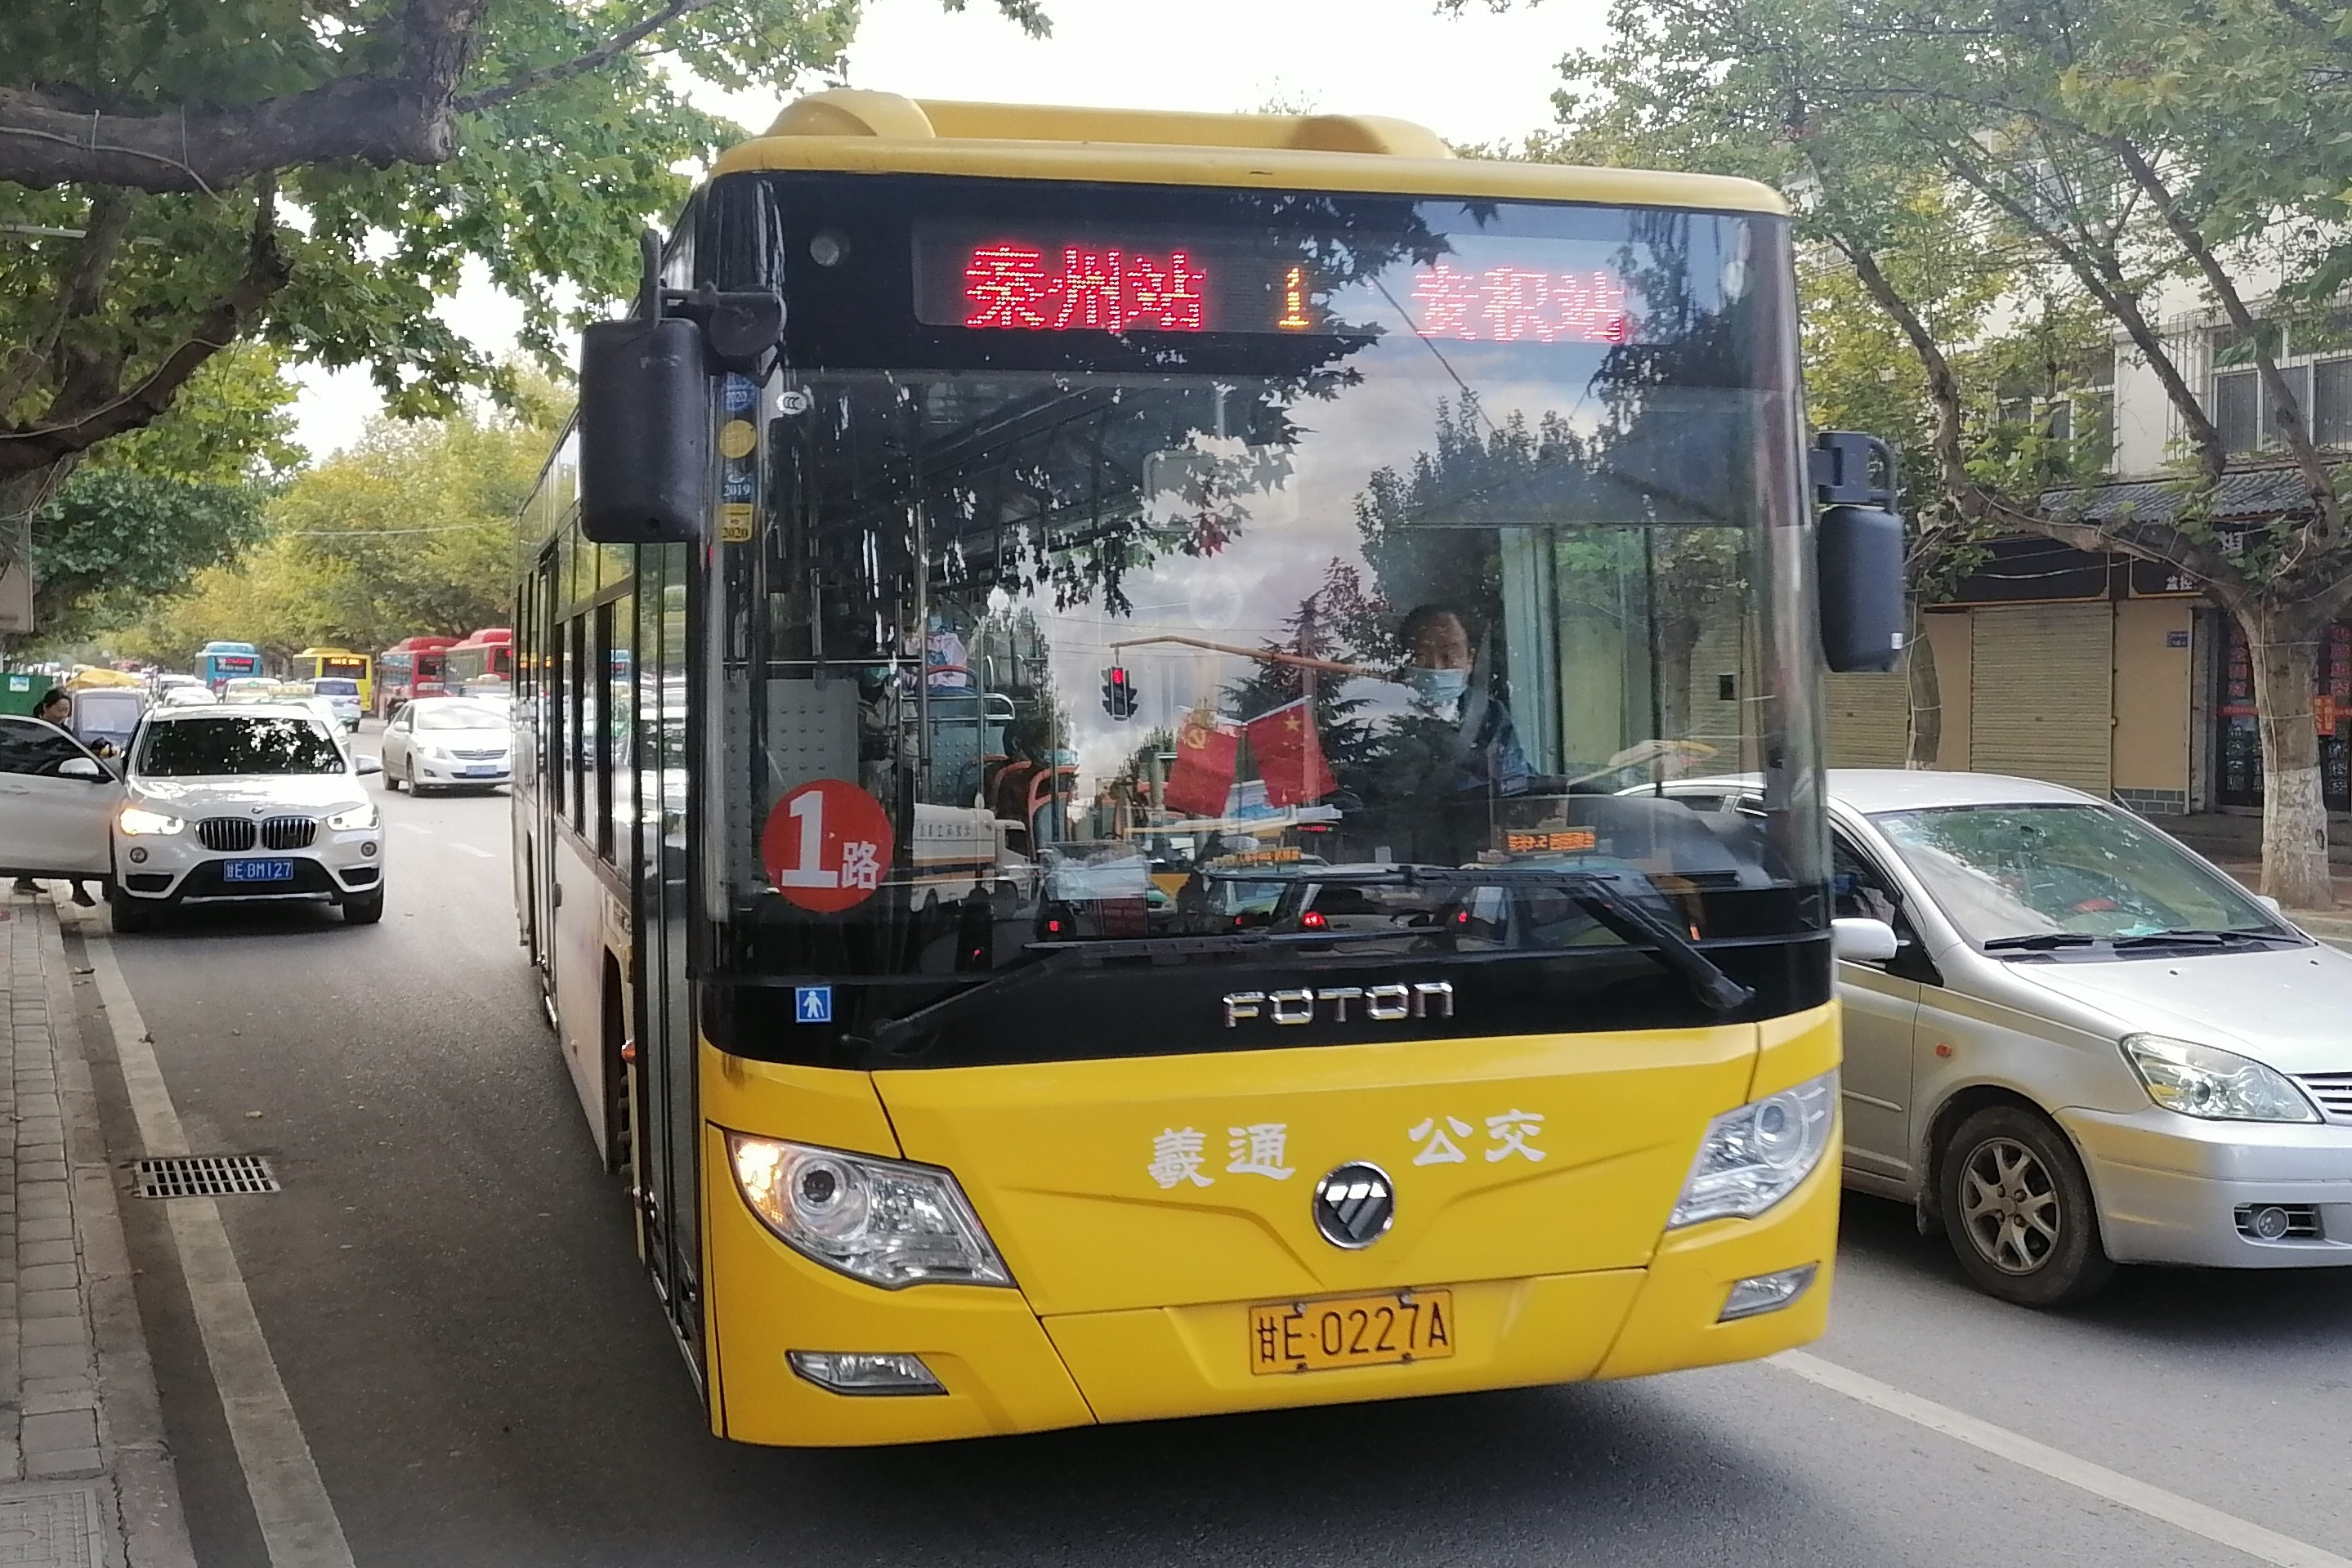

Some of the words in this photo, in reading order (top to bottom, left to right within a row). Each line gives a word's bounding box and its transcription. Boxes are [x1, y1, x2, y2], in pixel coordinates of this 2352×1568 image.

[965, 247, 1204, 331] 秦州站
[1278, 267, 1310, 328] 1
[1410, 264, 1624, 343] 麦积站
[723, 485, 750, 497] 2019
[722, 526, 749, 539] 2020
[1223, 981, 1454, 1027] FOTON
[1408, 1108, 1546, 1166] 公交
